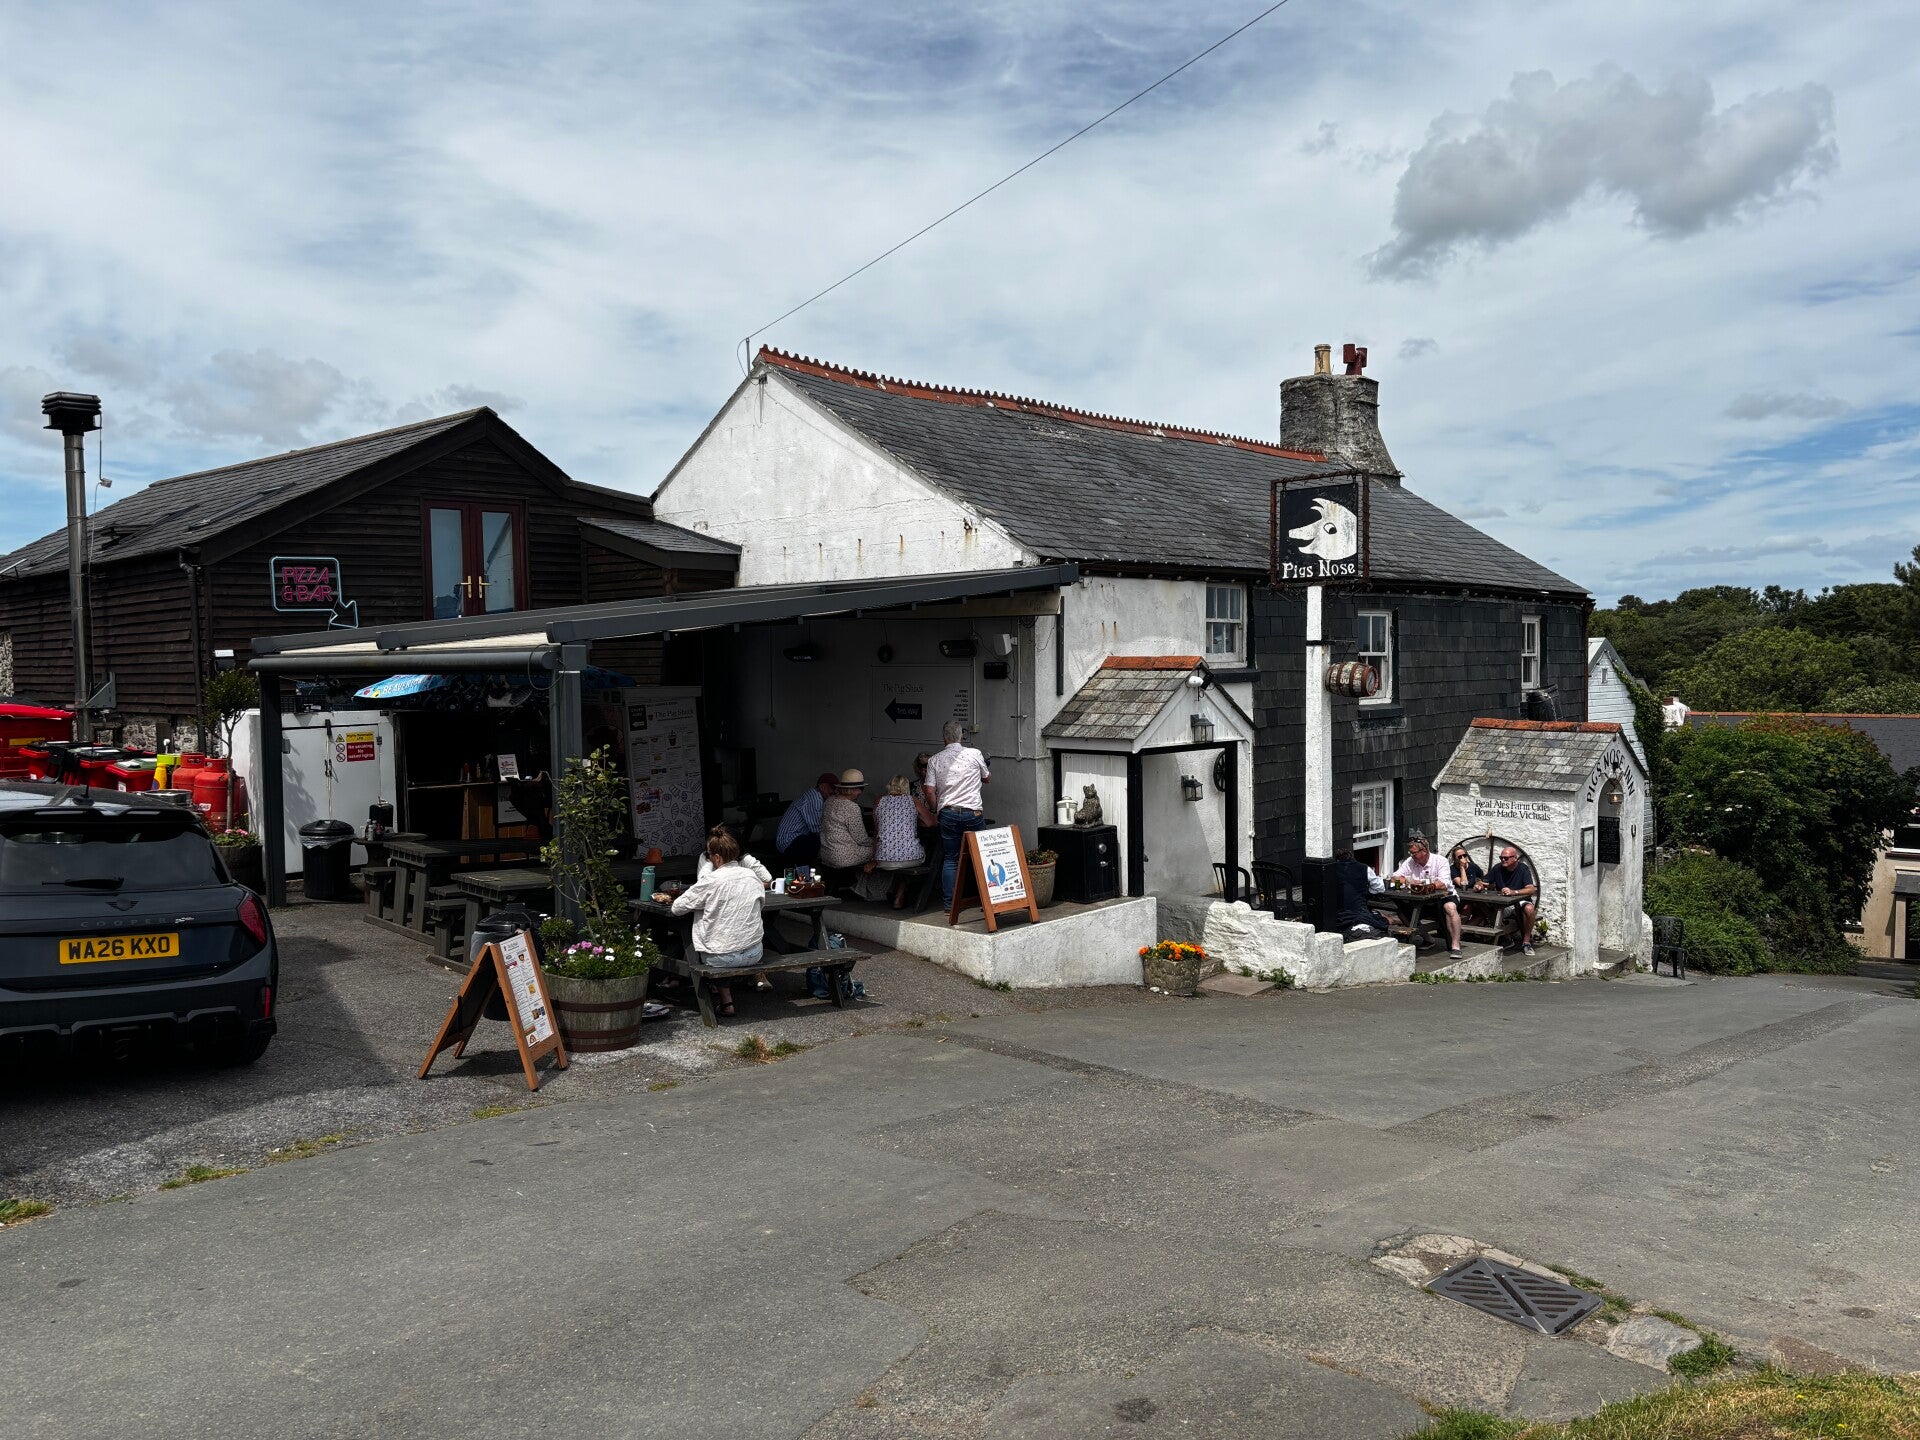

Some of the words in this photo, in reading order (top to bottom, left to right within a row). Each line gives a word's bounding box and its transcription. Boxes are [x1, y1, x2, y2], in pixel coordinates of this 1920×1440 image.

[282, 566, 329, 585] PIZZA
[1282, 562, 1314, 579] Pigs
[1318, 559, 1356, 577] Nose
[281, 585, 293, 602] &
[296, 585, 333, 602] BAR
[1586, 762, 1602, 803] PIGS
[1603, 748, 1625, 770] NOSE
[1623, 765, 1635, 796] INN
[1475, 799, 1492, 809] Real
[1494, 800, 1510, 810] Ales
[1511, 801, 1530, 811] Farm
[1474, 808, 1496, 817] Home
[1497, 809, 1518, 819] Made
[1519, 811, 1552, 821] Victuals
[80, 918, 168, 928] COOPER
[68, 939, 125, 960] WA26
[131, 936, 171, 956] KXO
